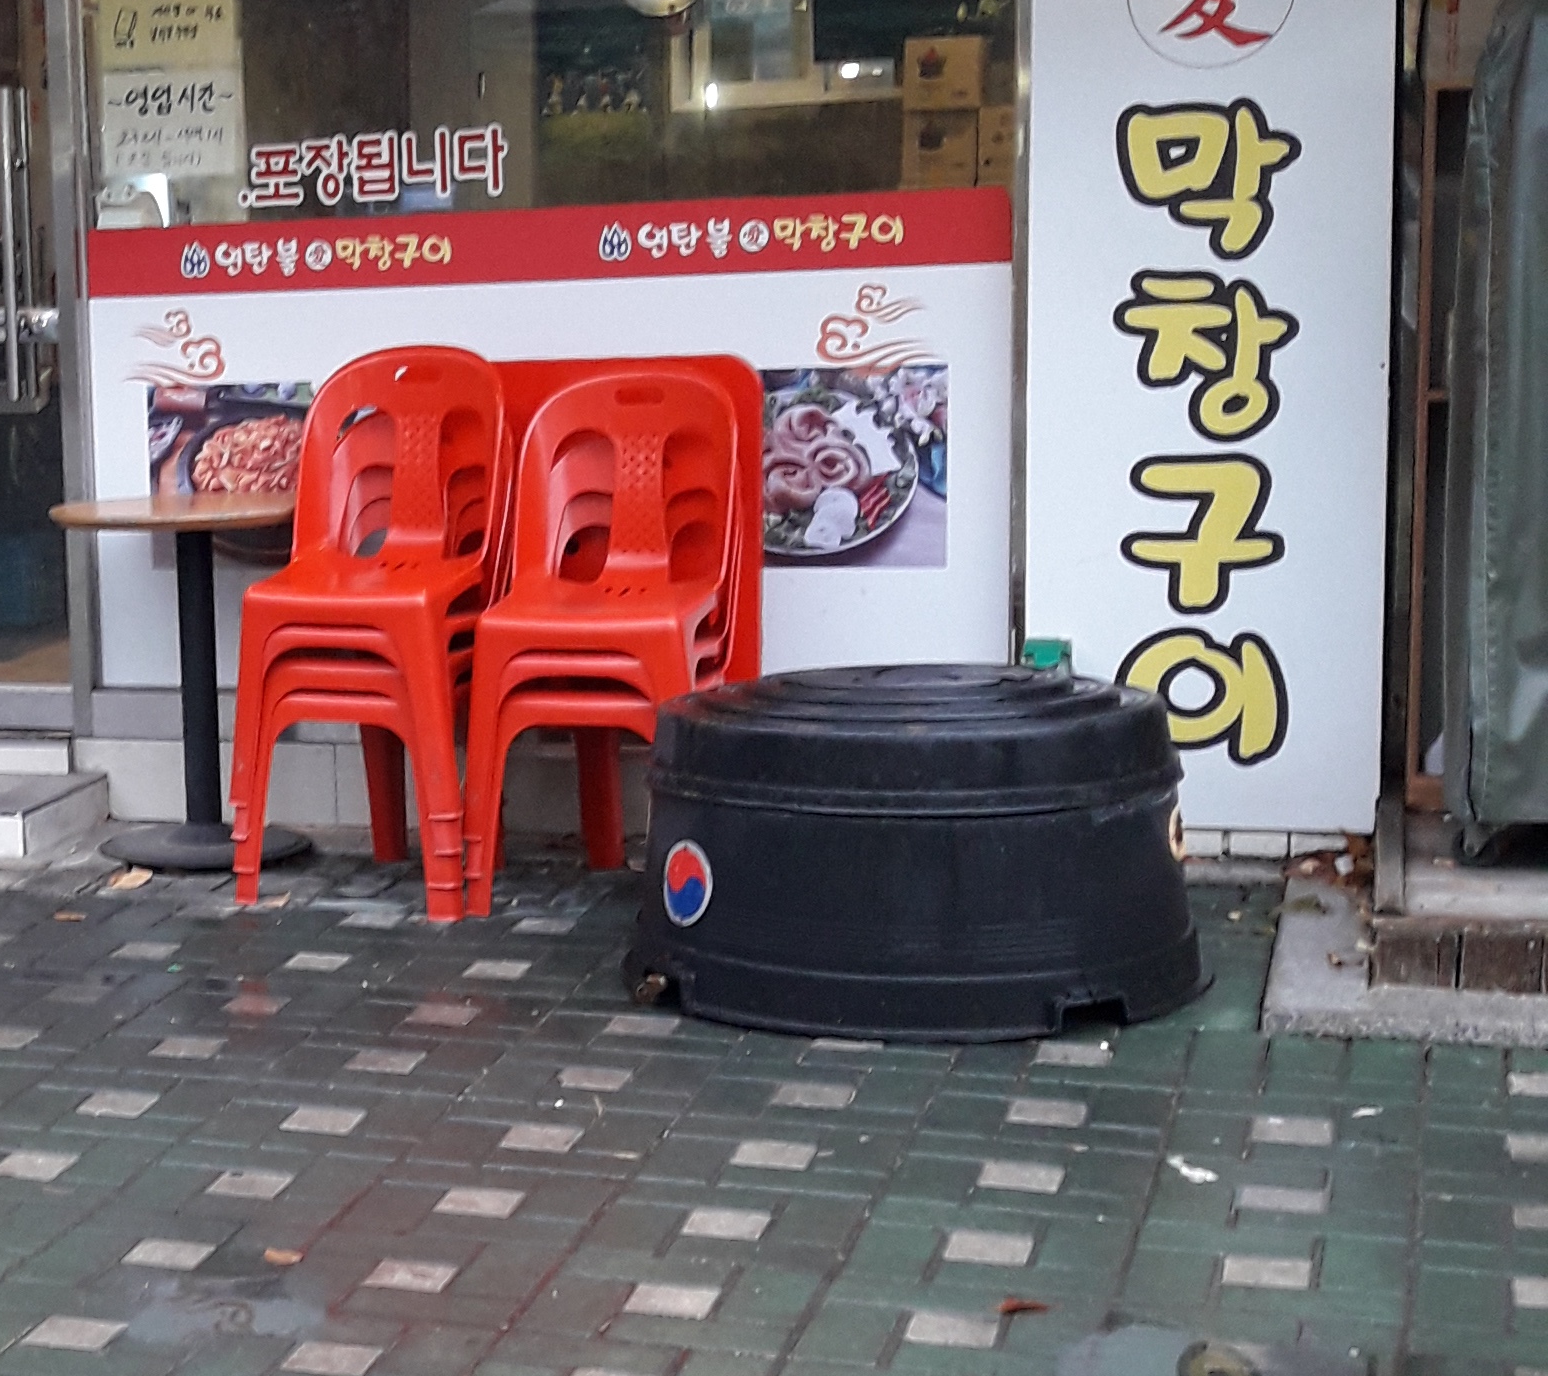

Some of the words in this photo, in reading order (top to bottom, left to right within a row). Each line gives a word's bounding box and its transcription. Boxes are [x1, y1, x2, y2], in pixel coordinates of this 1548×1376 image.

[214, 236, 300, 277] 연탄불
[335, 233, 453, 272] 막창구이
[637, 217, 733, 258] 연탄불
[773, 212, 905, 252] 막창구이
[1115, 98, 1302, 767] 막창구이
